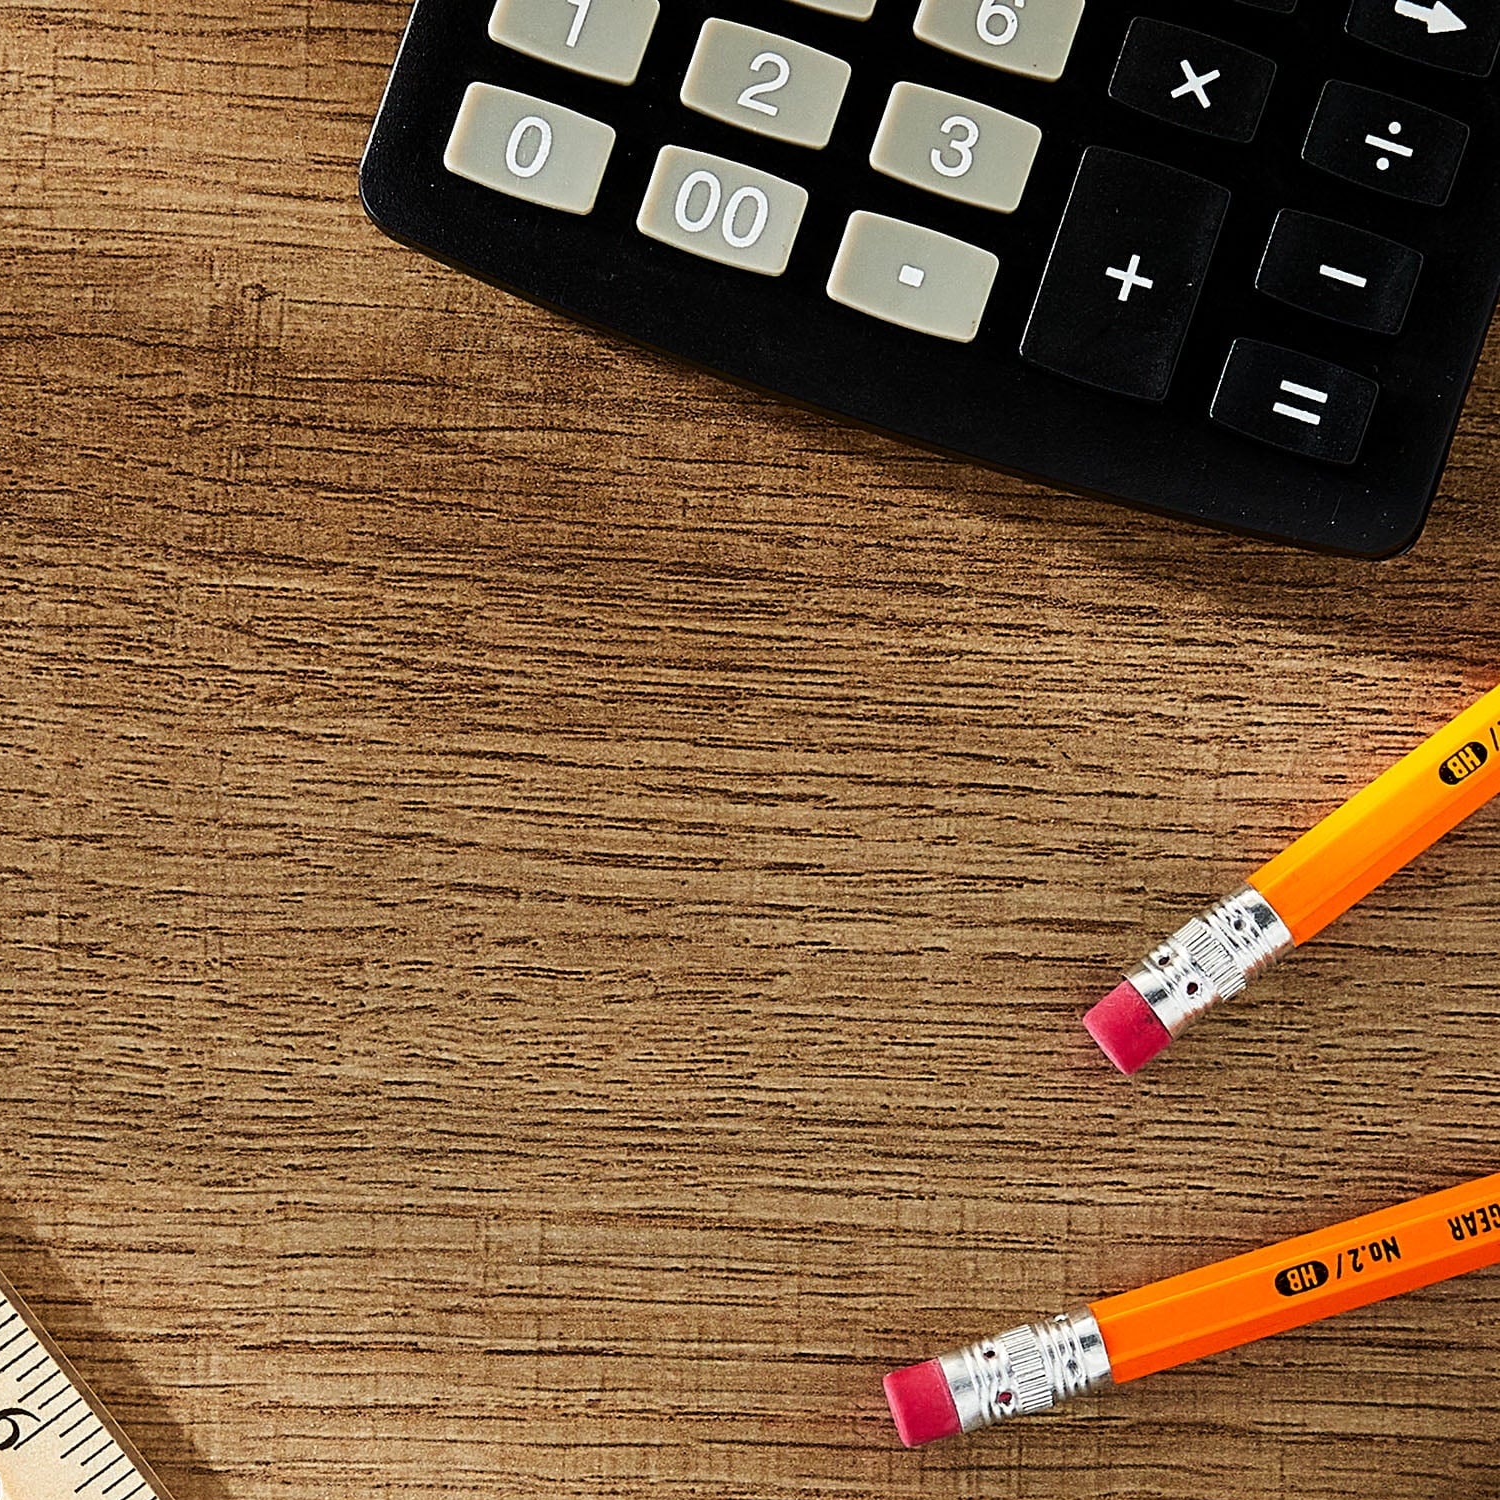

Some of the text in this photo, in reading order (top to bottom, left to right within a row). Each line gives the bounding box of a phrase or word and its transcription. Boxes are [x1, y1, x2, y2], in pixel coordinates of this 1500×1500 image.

[564, 0, 589, 48] 1
[975, 0, 1025, 46] 6
[737, 51, 791, 117] 2
[505, 116, 553, 178] 0
[930, 115, 980, 178] 3
[674, 170, 769, 248] 00
[1447, 746, 1481, 779] HB
[1447, 1203, 1500, 1241] GEAR
[1286, 1264, 1318, 1292] HB
